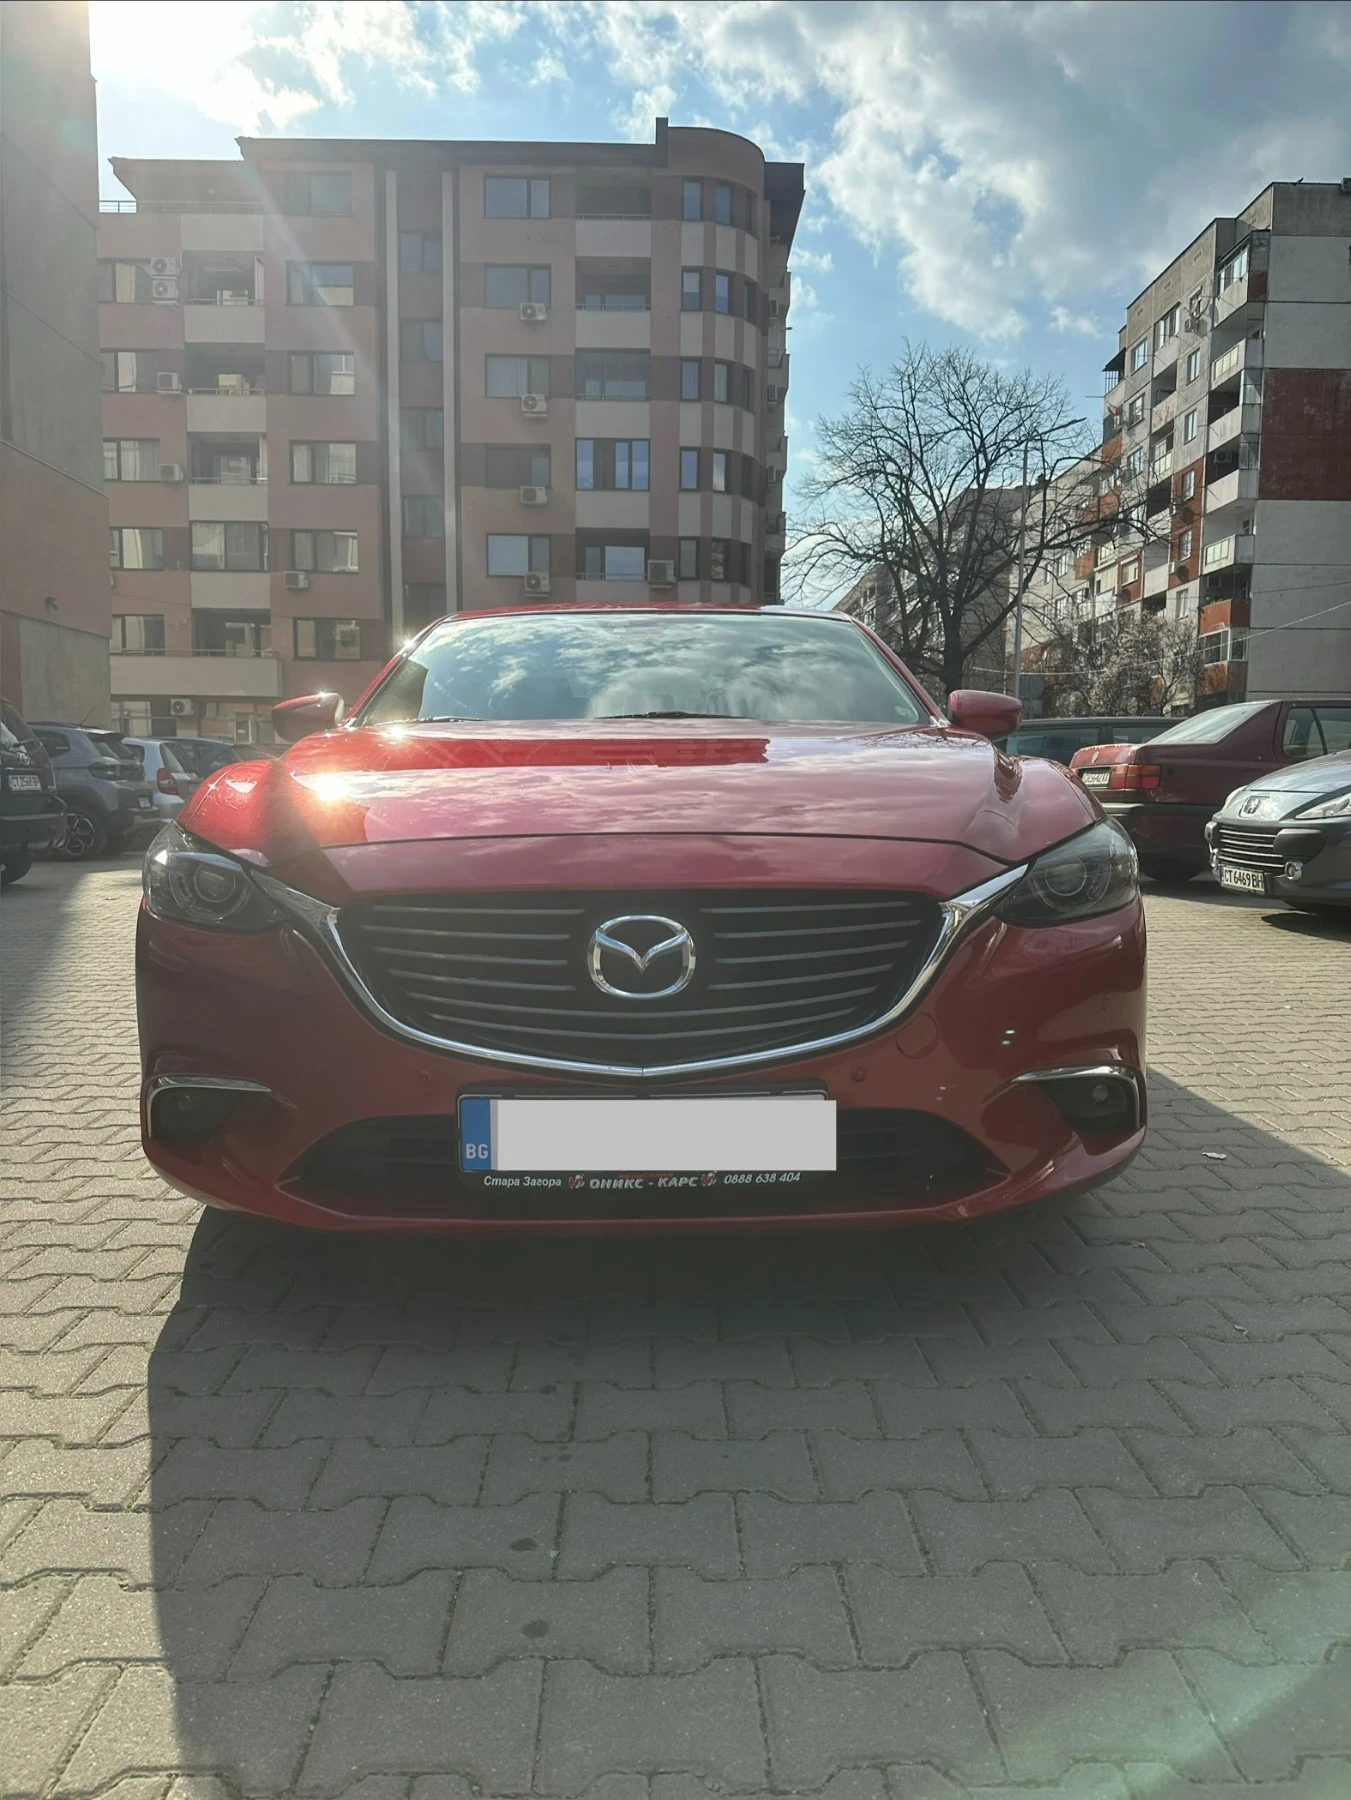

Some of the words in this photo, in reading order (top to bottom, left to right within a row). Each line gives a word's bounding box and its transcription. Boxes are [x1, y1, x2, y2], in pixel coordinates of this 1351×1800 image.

[466, 1143, 488, 1159] BG
[483, 1175, 520, 1188] Стара
[522, 1176, 562, 1188] Загора
[589, 1178, 644, 1189] ОНИКС
[657, 1176, 699, 1188] КАРС
[723, 1174, 753, 1185] 0888
[755, 1173, 777, 1184] 638
[778, 1172, 801, 1183] 404
